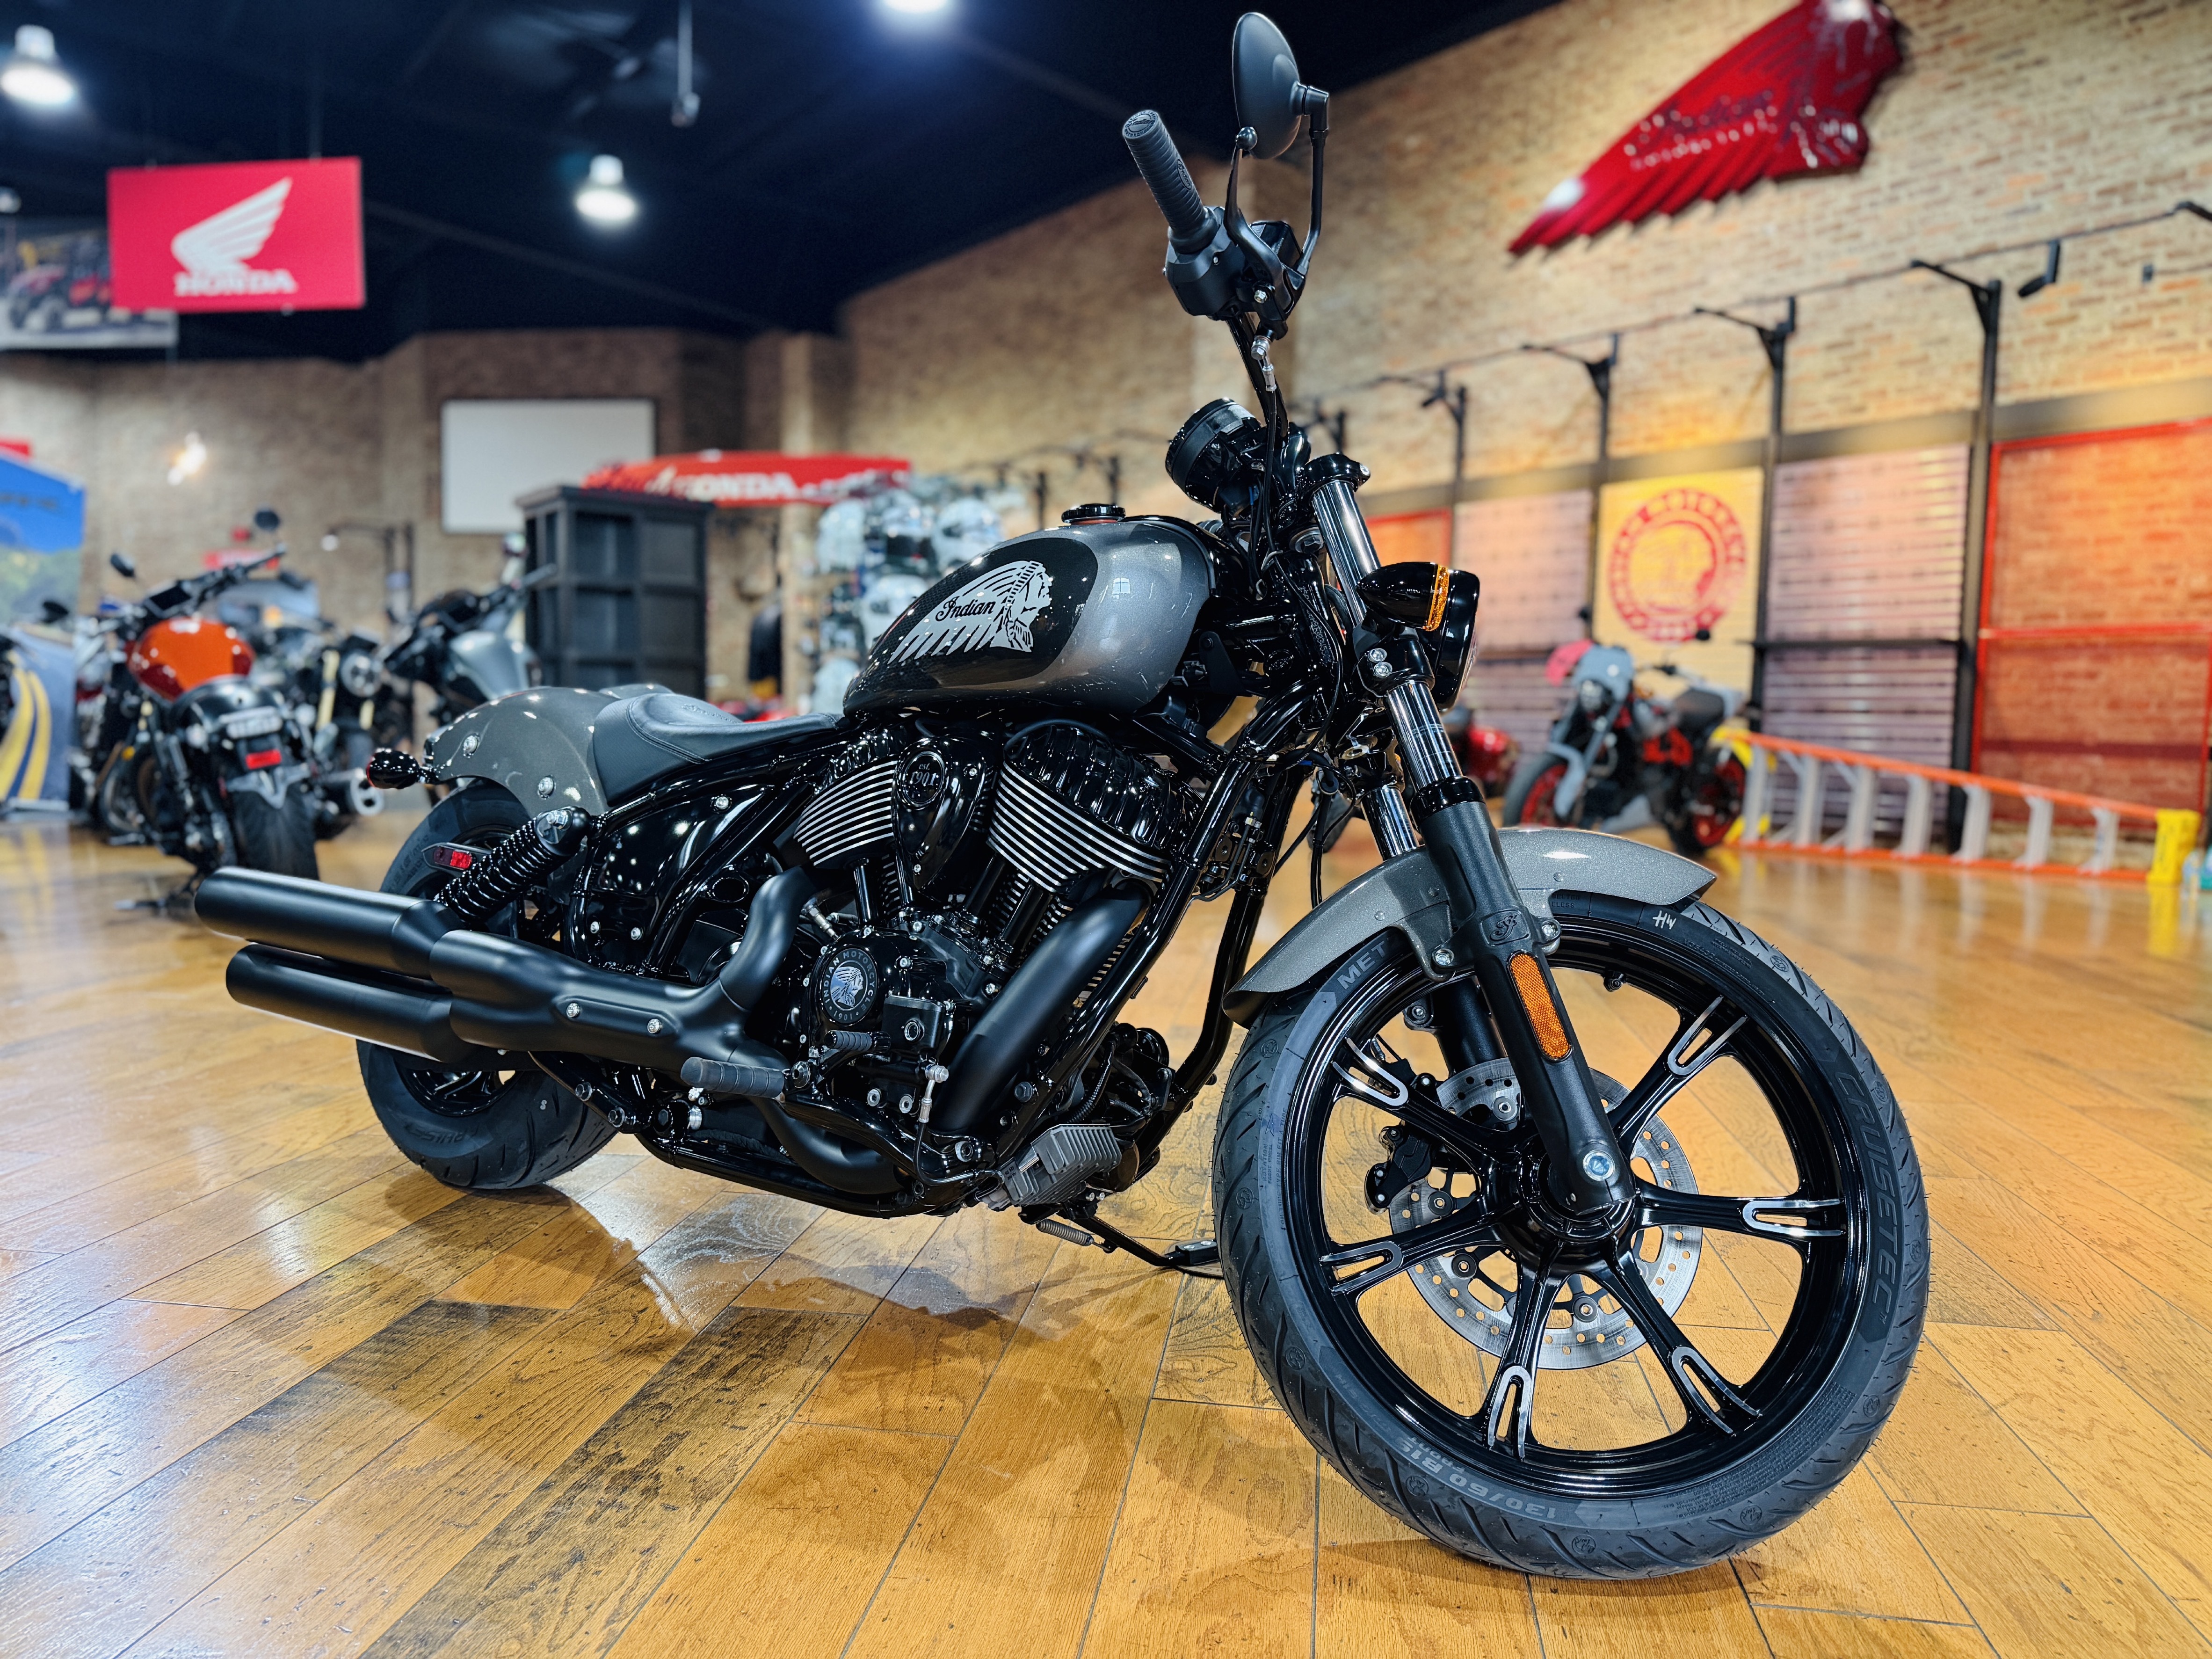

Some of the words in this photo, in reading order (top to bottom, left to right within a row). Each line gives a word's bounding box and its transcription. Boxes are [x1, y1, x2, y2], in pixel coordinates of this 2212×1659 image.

[174, 269, 298, 297] HONDA
[935, 596, 996, 621] Indian
[910, 771, 937, 786] 1901
[823, 957, 840, 1004] INDIAN
[843, 951, 875, 1011] MOTORCYCLE
[1834, 1071, 1900, 1313] CRUISETEC
[1449, 1473, 1556, 1519] 130/60
